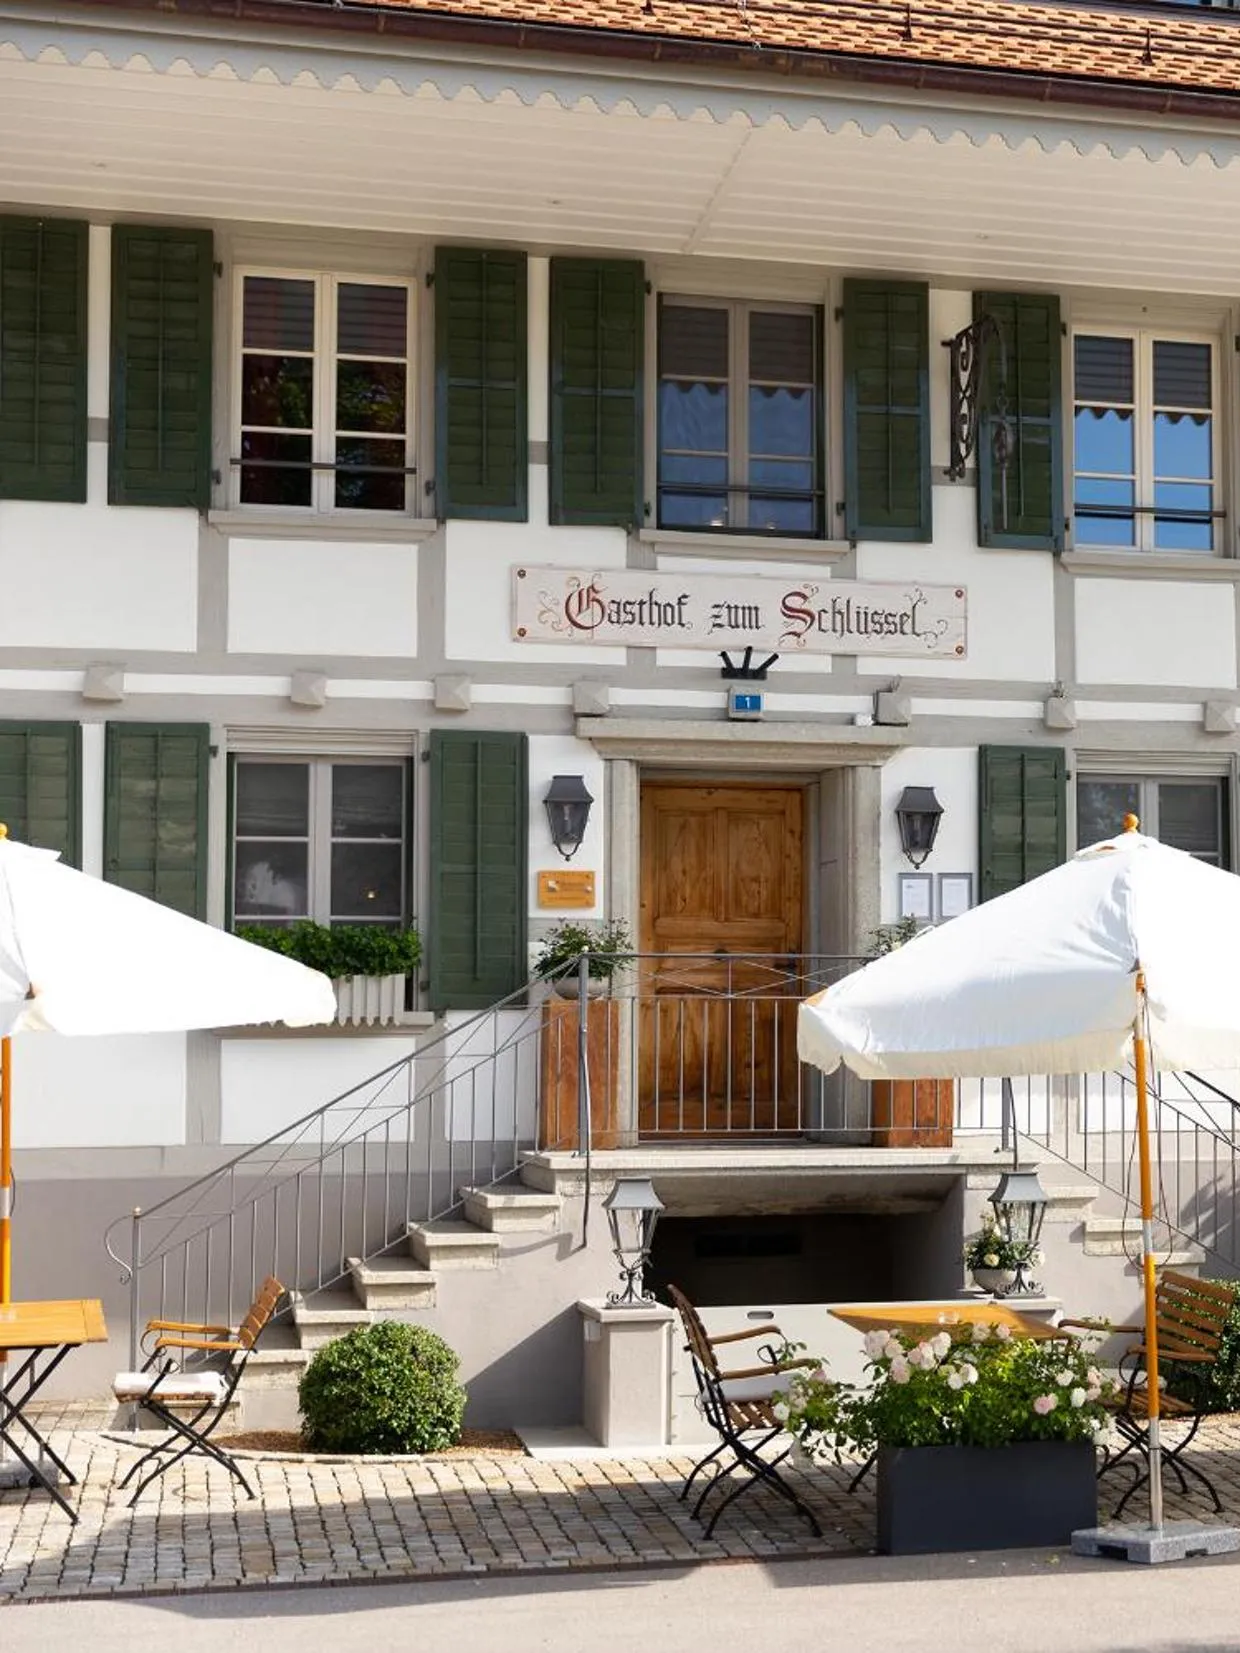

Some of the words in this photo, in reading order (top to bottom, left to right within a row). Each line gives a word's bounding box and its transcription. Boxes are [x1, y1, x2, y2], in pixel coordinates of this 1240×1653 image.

[564, 578, 692, 631] Gasthof
[707, 601, 765, 634] zum
[778, 587, 930, 645] Schlüssel
